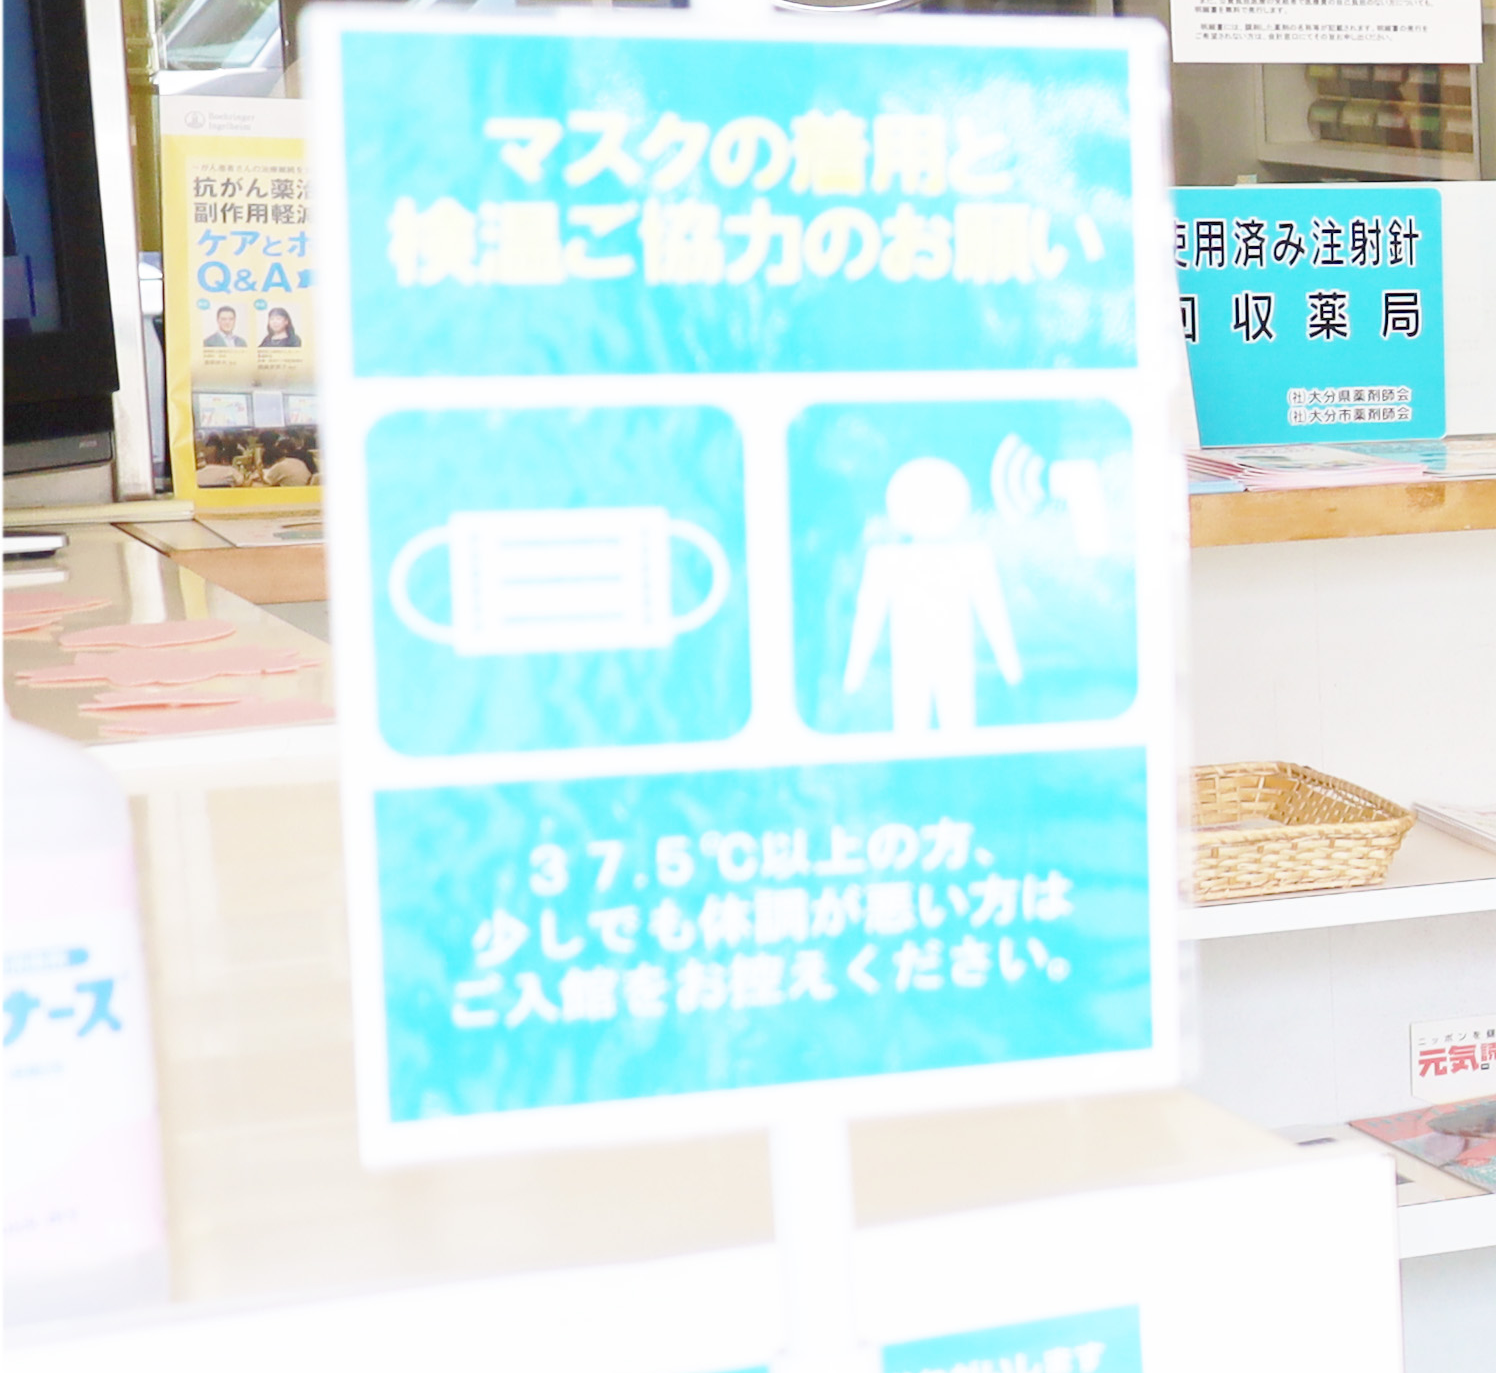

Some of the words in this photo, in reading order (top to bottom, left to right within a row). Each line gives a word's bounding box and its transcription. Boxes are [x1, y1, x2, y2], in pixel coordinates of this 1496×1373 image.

[483, 109, 1016, 198] マスクの着用と
[197, 260, 293, 295] Q&A
[388, 196, 1103, 287] 検温ご協力のお願い
[470, 872, 1075, 968] 少しでも体調が悪い方は
[449, 937, 1076, 1029] ご入館をお控えください。
